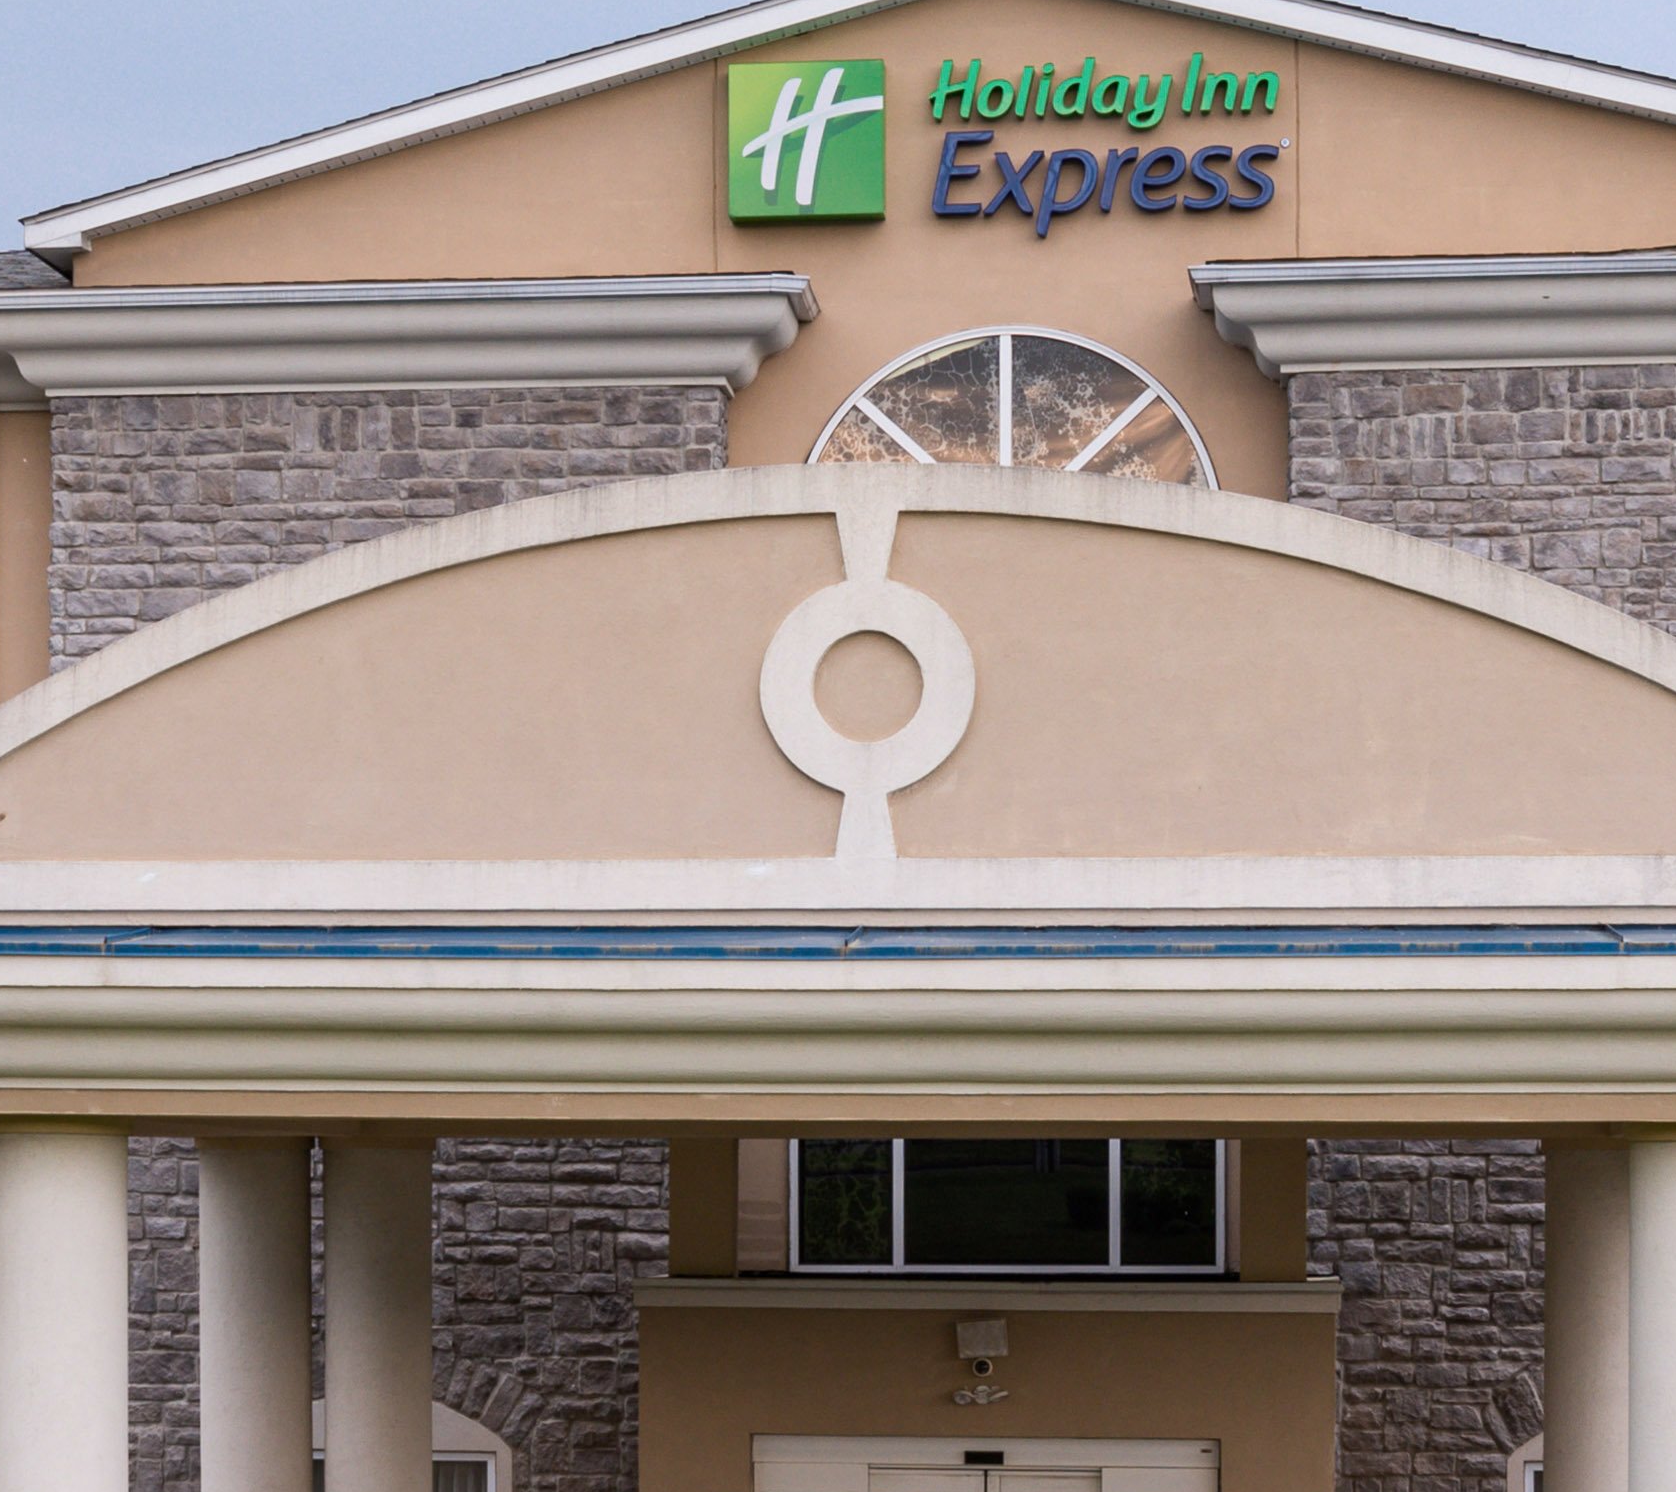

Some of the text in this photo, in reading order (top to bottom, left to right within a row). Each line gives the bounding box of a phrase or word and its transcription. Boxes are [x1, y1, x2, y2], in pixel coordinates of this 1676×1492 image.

[929, 53, 1280, 130] Holiday Inn
[931, 130, 1280, 238] Express
